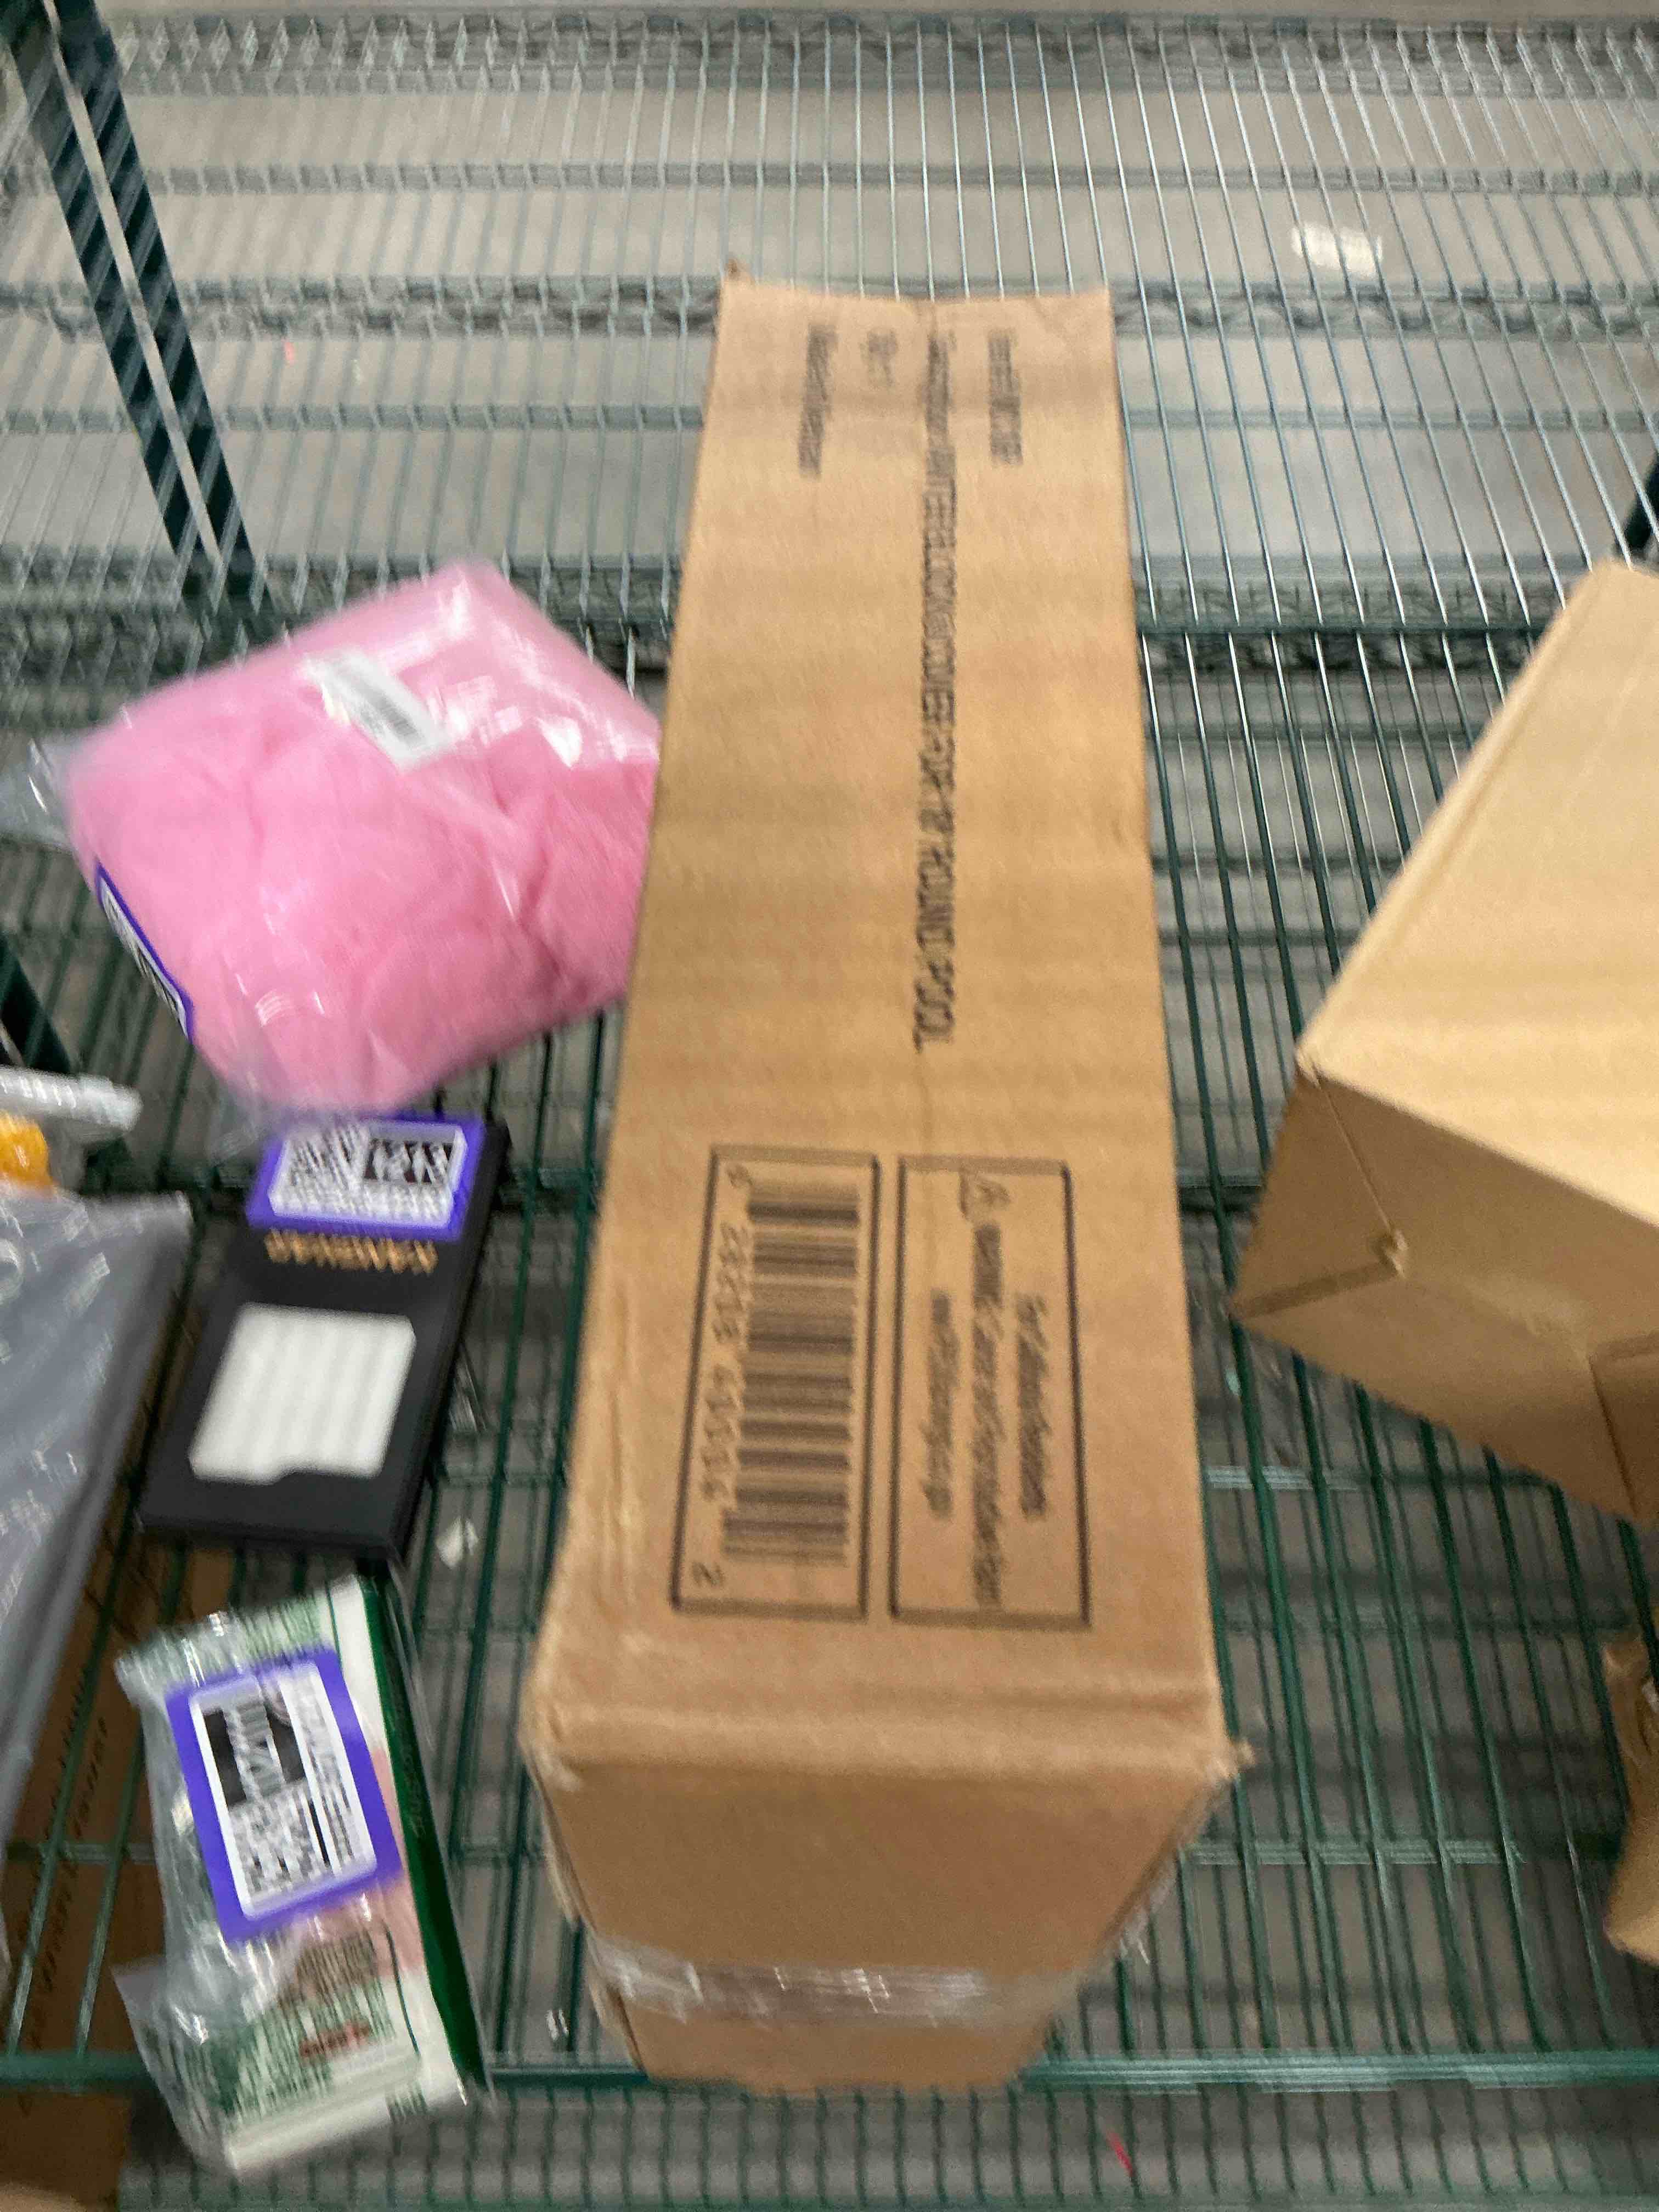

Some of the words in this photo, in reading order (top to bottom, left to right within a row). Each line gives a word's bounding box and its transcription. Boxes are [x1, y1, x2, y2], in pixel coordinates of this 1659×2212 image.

[916, 840, 955, 952] ROUND
[913, 957, 955, 1055] POOL
[691, 1560, 726, 1589] 2
